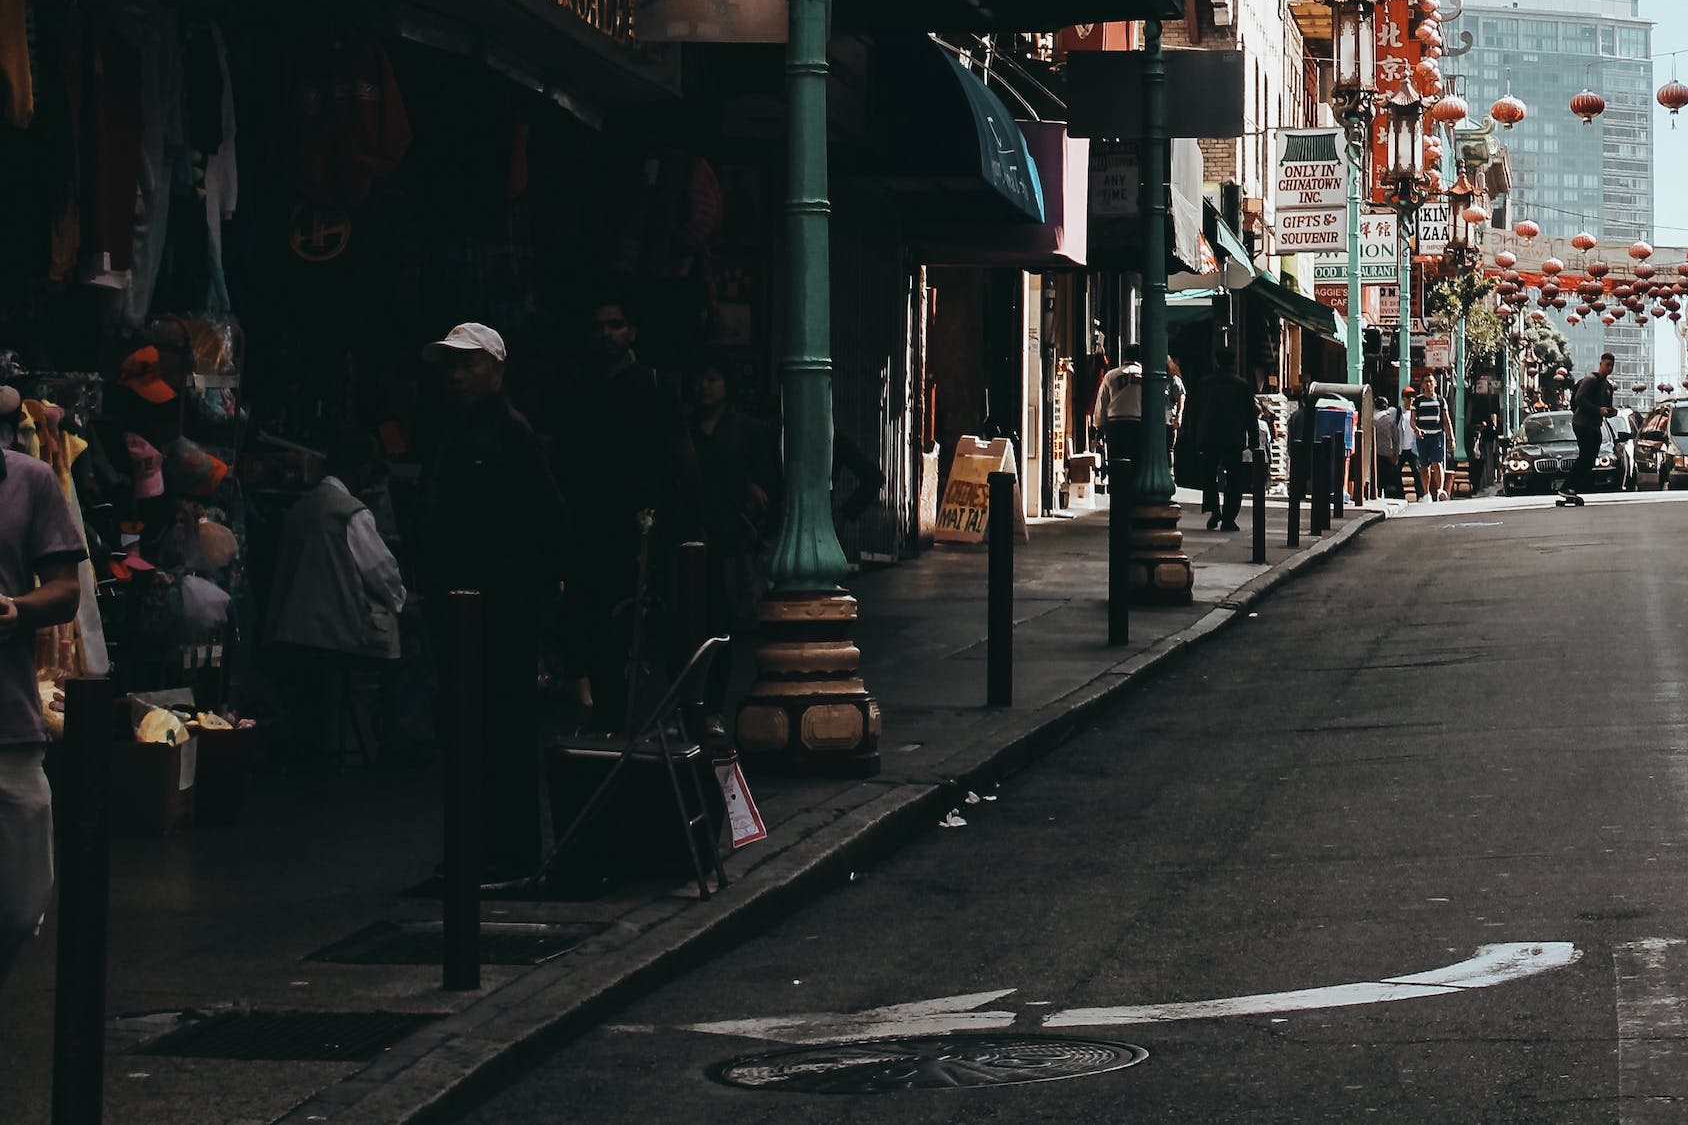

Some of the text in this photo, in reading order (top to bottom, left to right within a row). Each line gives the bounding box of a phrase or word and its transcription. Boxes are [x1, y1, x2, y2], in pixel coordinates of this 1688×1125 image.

[1284, 164, 1337, 178] ONLY IN
[1104, 175, 1126, 187] ANY
[1278, 177, 1342, 191] CHINATOWN
[1103, 188, 1127, 201] TIME
[1299, 191, 1323, 203] INC.
[1283, 213, 1337, 229] GIFTS &
[1280, 231, 1339, 244] SOUVENIR
[1315, 266, 1396, 278] OOD RAURANT
[1315, 287, 1347, 297] AGGIE'S
[1331, 299, 1347, 307] CAF
